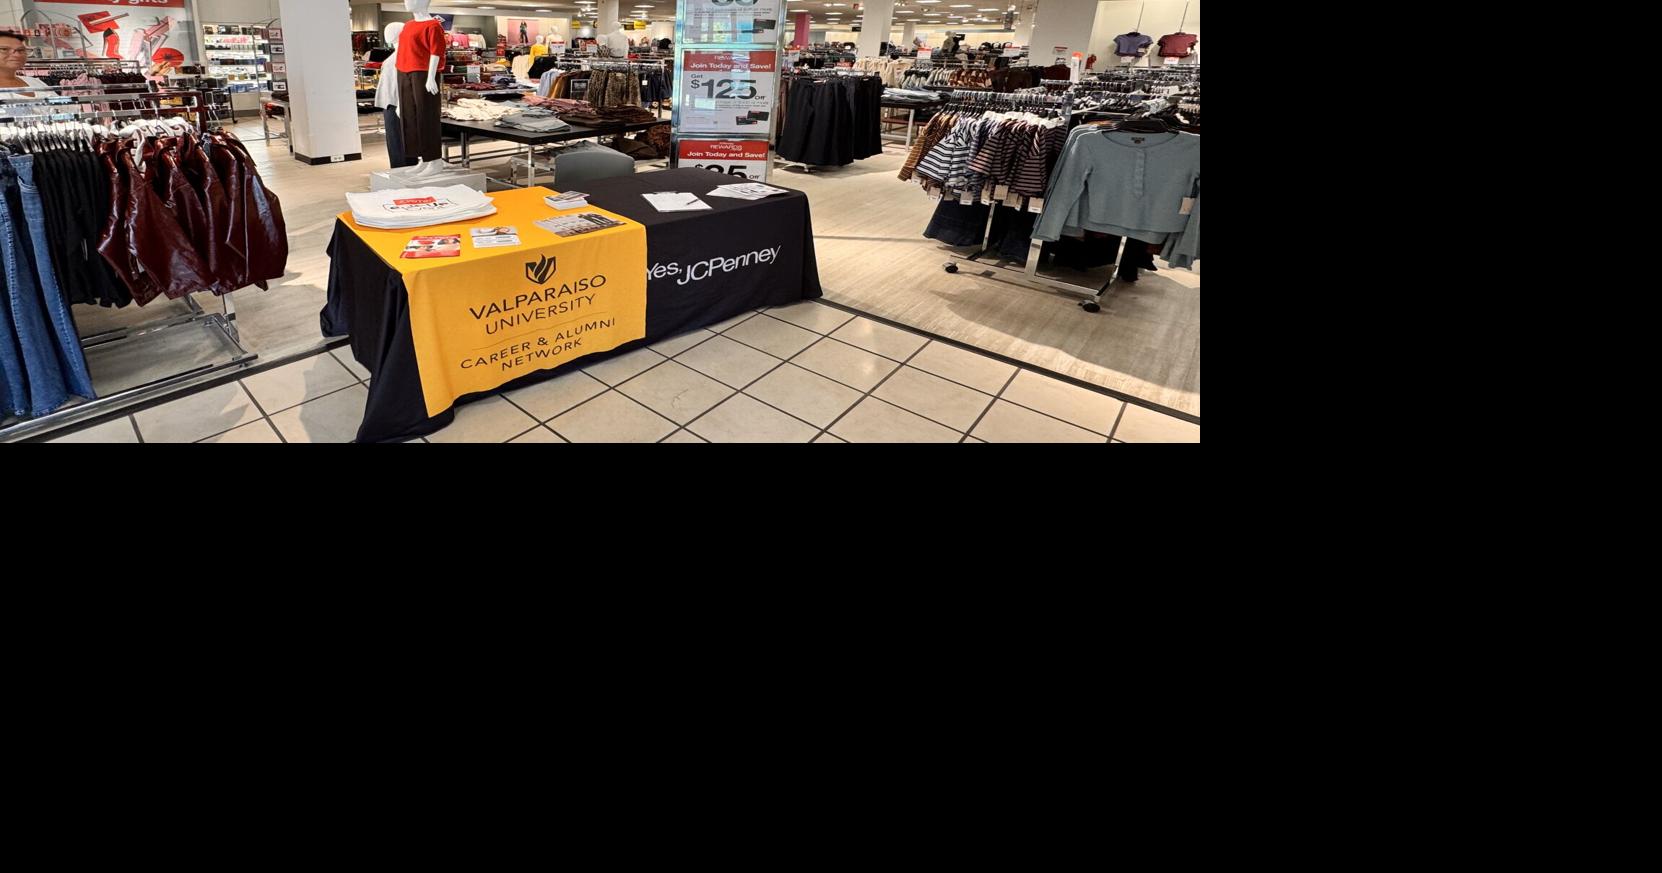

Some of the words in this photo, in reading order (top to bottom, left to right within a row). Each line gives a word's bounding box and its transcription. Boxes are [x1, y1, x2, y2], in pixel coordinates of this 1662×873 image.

[708, 62, 732, 70] Today
[646, 262, 683, 281] Yes,
[676, 245, 781, 286] JCPenney
[469, 274, 607, 320] VALPARAISO
[485, 293, 596, 335] UNIVERSITY
[460, 341, 531, 369] CAREER
[537, 336, 549, 346] &
[554, 317, 616, 343] ALUMNI
[501, 337, 583, 372] NETWORK
